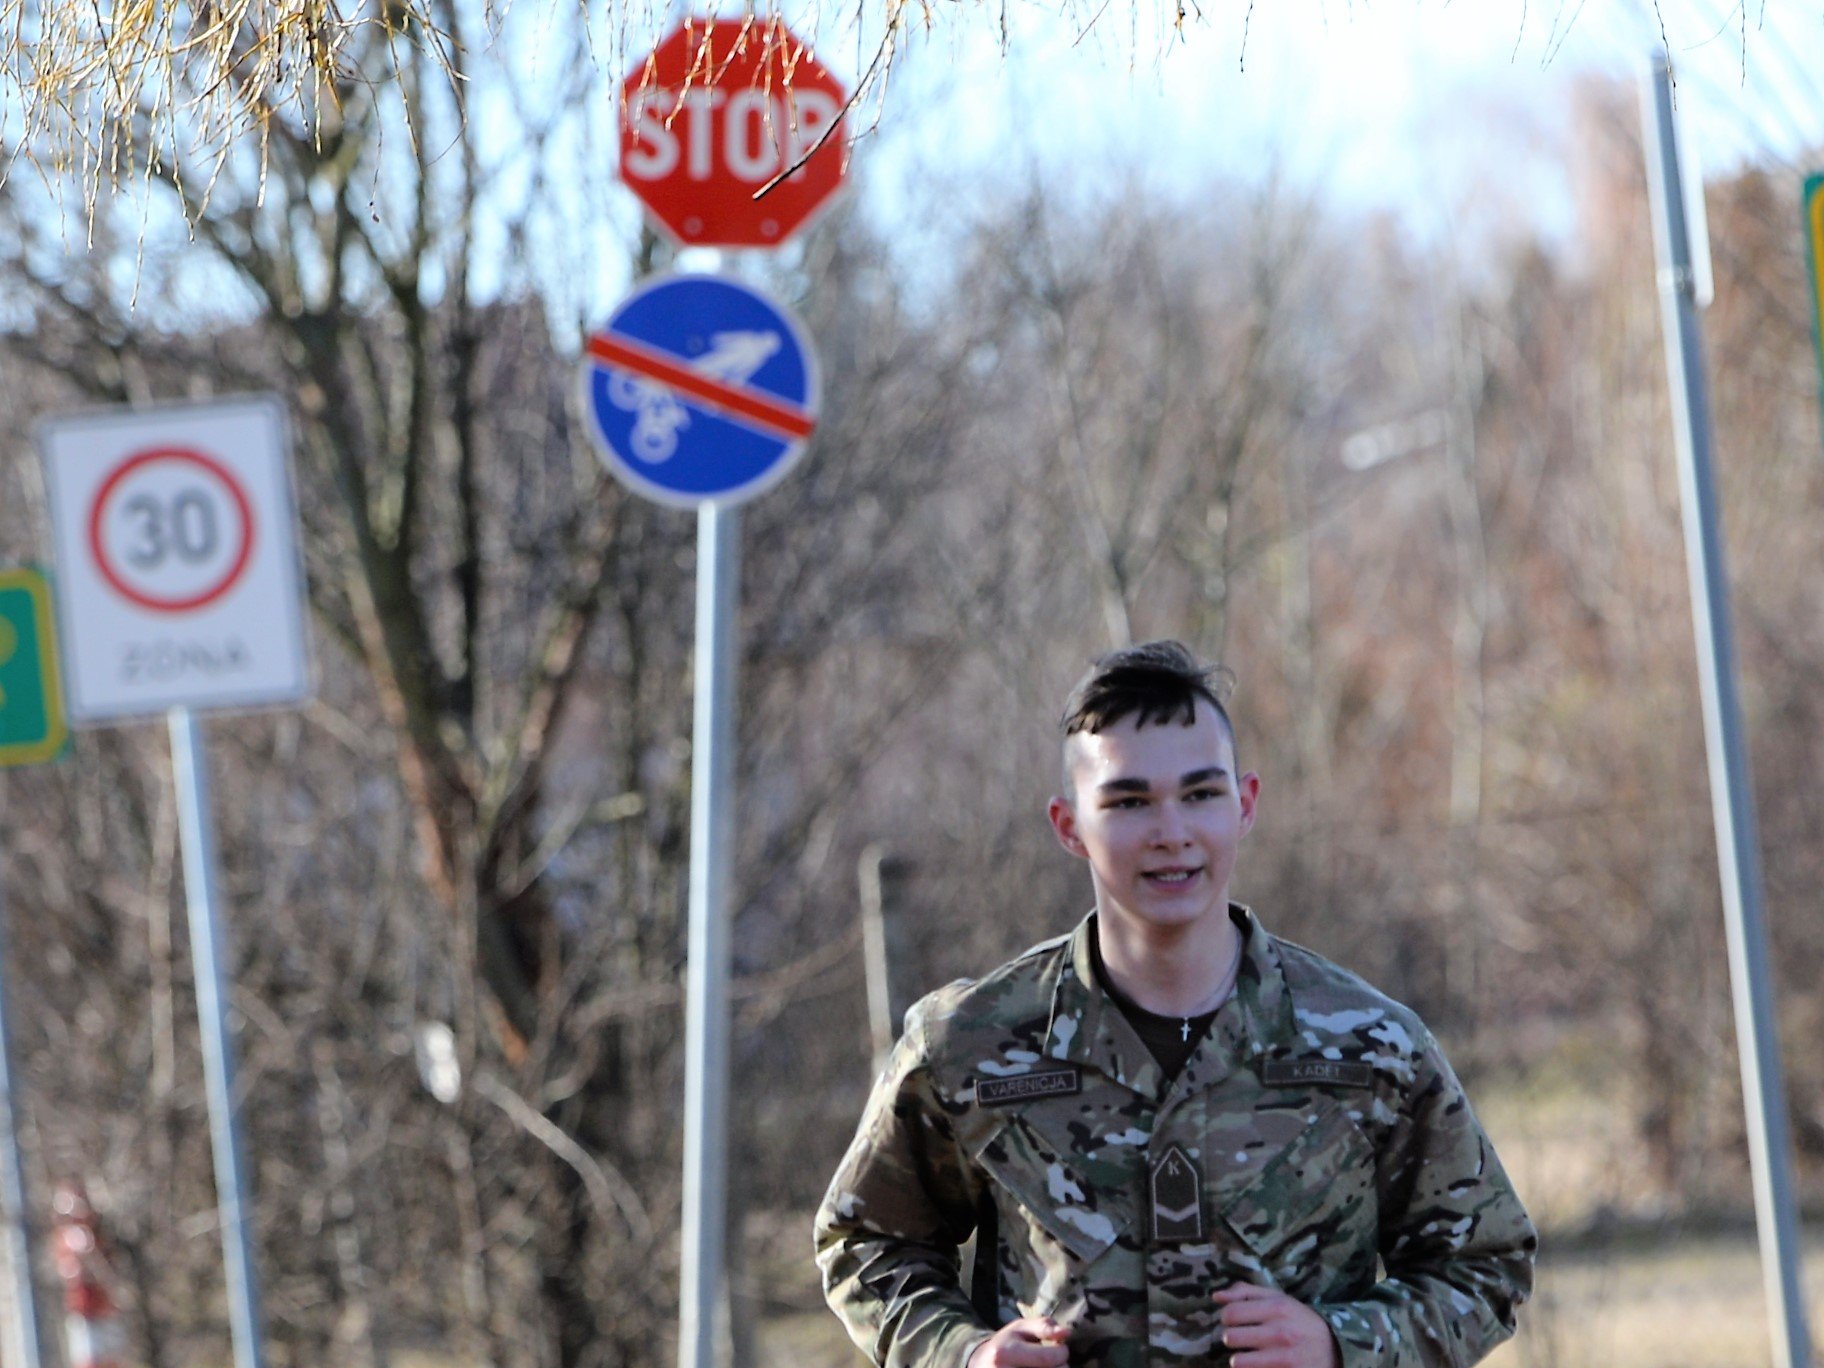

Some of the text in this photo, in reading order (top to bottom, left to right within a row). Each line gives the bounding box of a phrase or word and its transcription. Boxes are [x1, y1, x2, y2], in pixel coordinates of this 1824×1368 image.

[625, 86, 841, 182] STOP
[121, 488, 219, 570] 30
[1167, 1160, 1181, 1176] K
